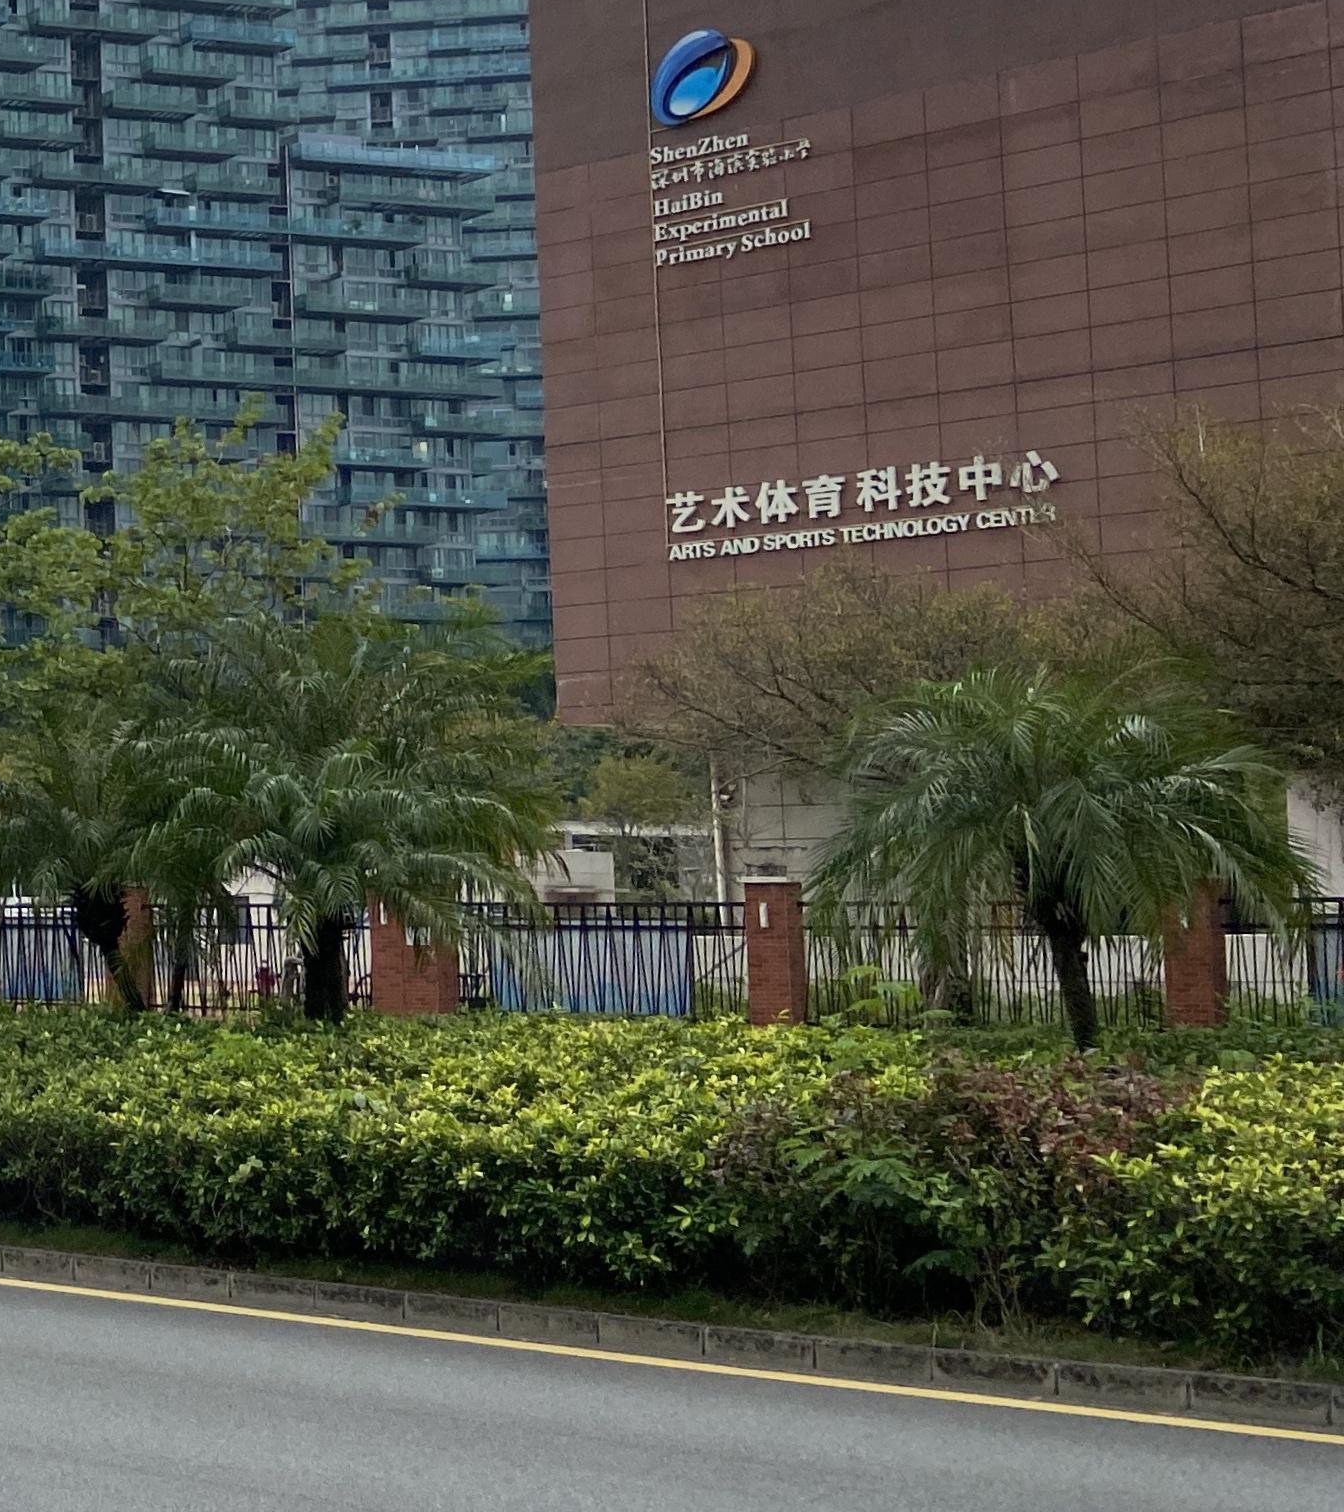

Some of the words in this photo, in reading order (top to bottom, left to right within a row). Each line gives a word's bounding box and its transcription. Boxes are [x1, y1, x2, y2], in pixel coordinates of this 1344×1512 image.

[650, 133, 749, 165] ShenZhen
[654, 190, 723, 217] HaiBin
[654, 199, 788, 242] Experimental
[655, 240, 737, 267] Primary
[741, 221, 811, 252] School
[666, 450, 1061, 534] 艺术体育科技中心
[669, 537, 715, 562] ARTS
[720, 534, 760, 556] AND
[763, 529, 835, 551] SPORTS
[840, 514, 970, 544] TECHNOLOGY
